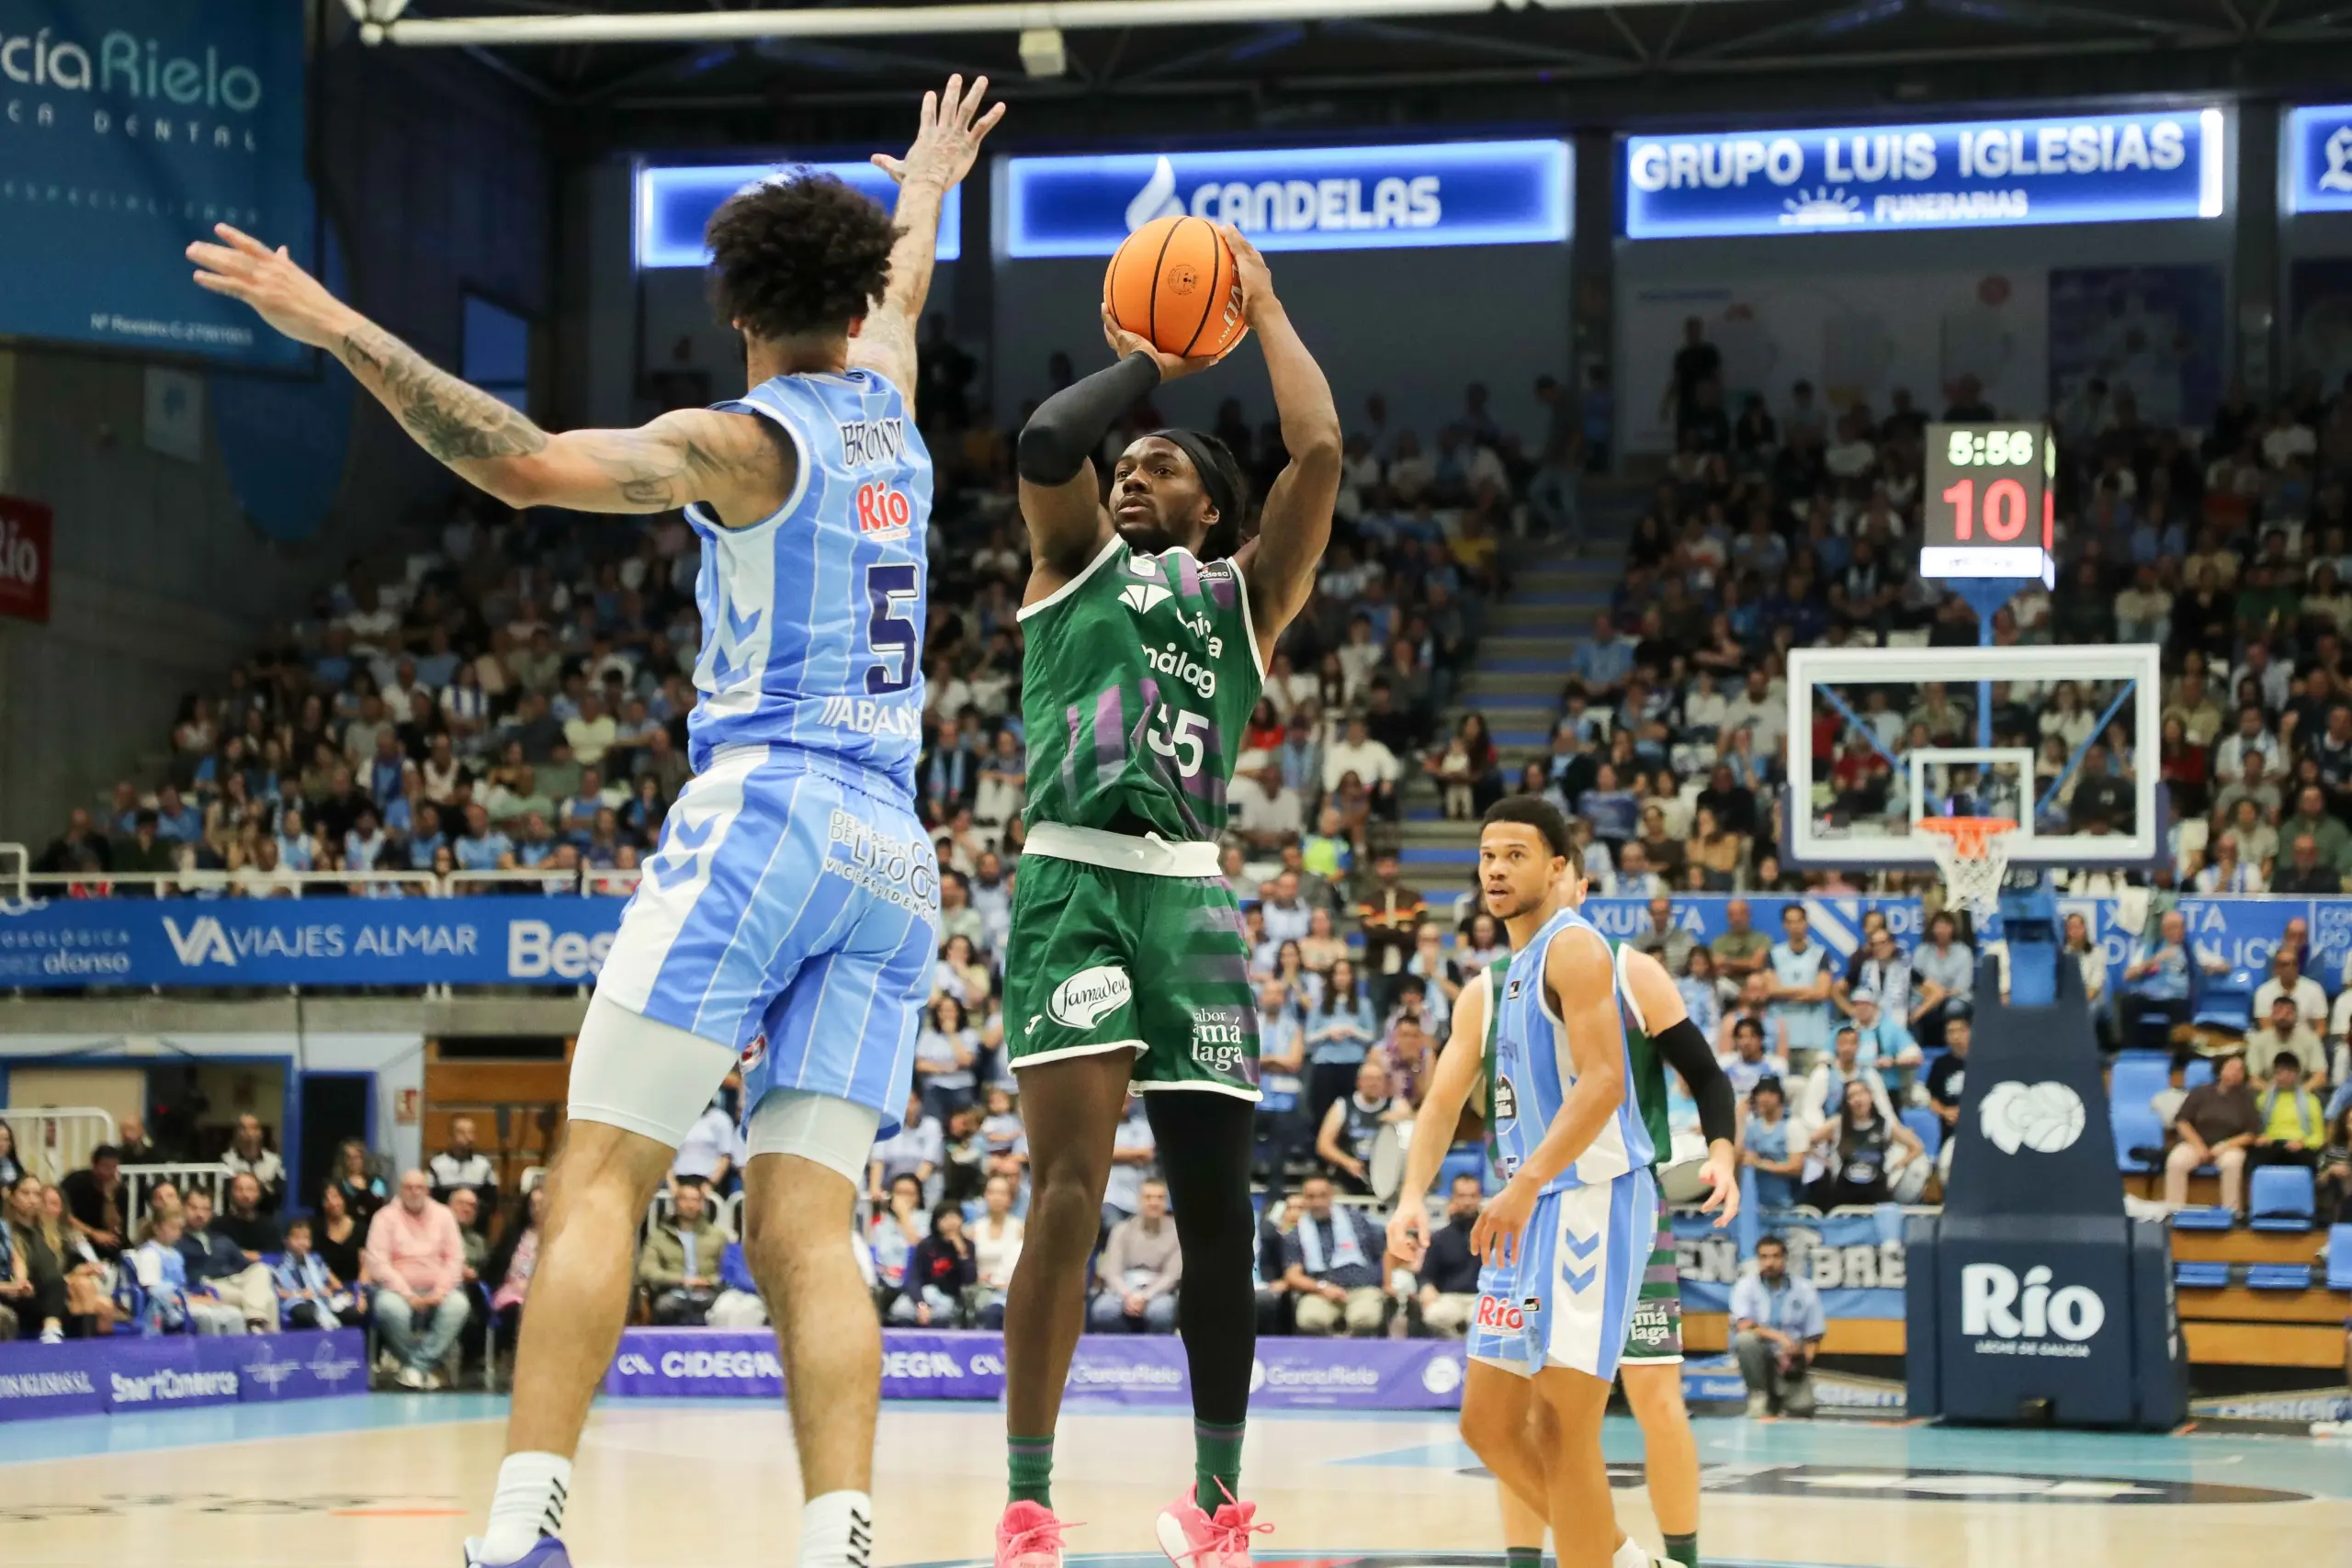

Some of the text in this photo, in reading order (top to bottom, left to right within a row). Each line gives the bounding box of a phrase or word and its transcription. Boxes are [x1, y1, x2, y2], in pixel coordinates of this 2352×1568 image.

[94, 109, 255, 152] DENTAL
[1631, 121, 2185, 193] GRUPO LUIS IGLESIAS
[1190, 175, 1442, 231] CANDELAS
[1874, 188, 2029, 222] FUNERARIAS
[1948, 431, 2033, 466] 5:56
[857, 481, 909, 531] Río
[1943, 479, 2028, 541] 10
[862, 562, 919, 695] 5
[231, 925, 345, 957] VIAJES
[354, 924, 478, 956] ALMAR
[1199, 1016, 1242, 1043] má
[1192, 1037, 1244, 1071] laga
[1476, 1295, 1523, 1329] Río
[1962, 1263, 2105, 1340] Río
[2018, 1341, 2037, 1355] DE
[2038, 1342, 2090, 1358] GALICIA
